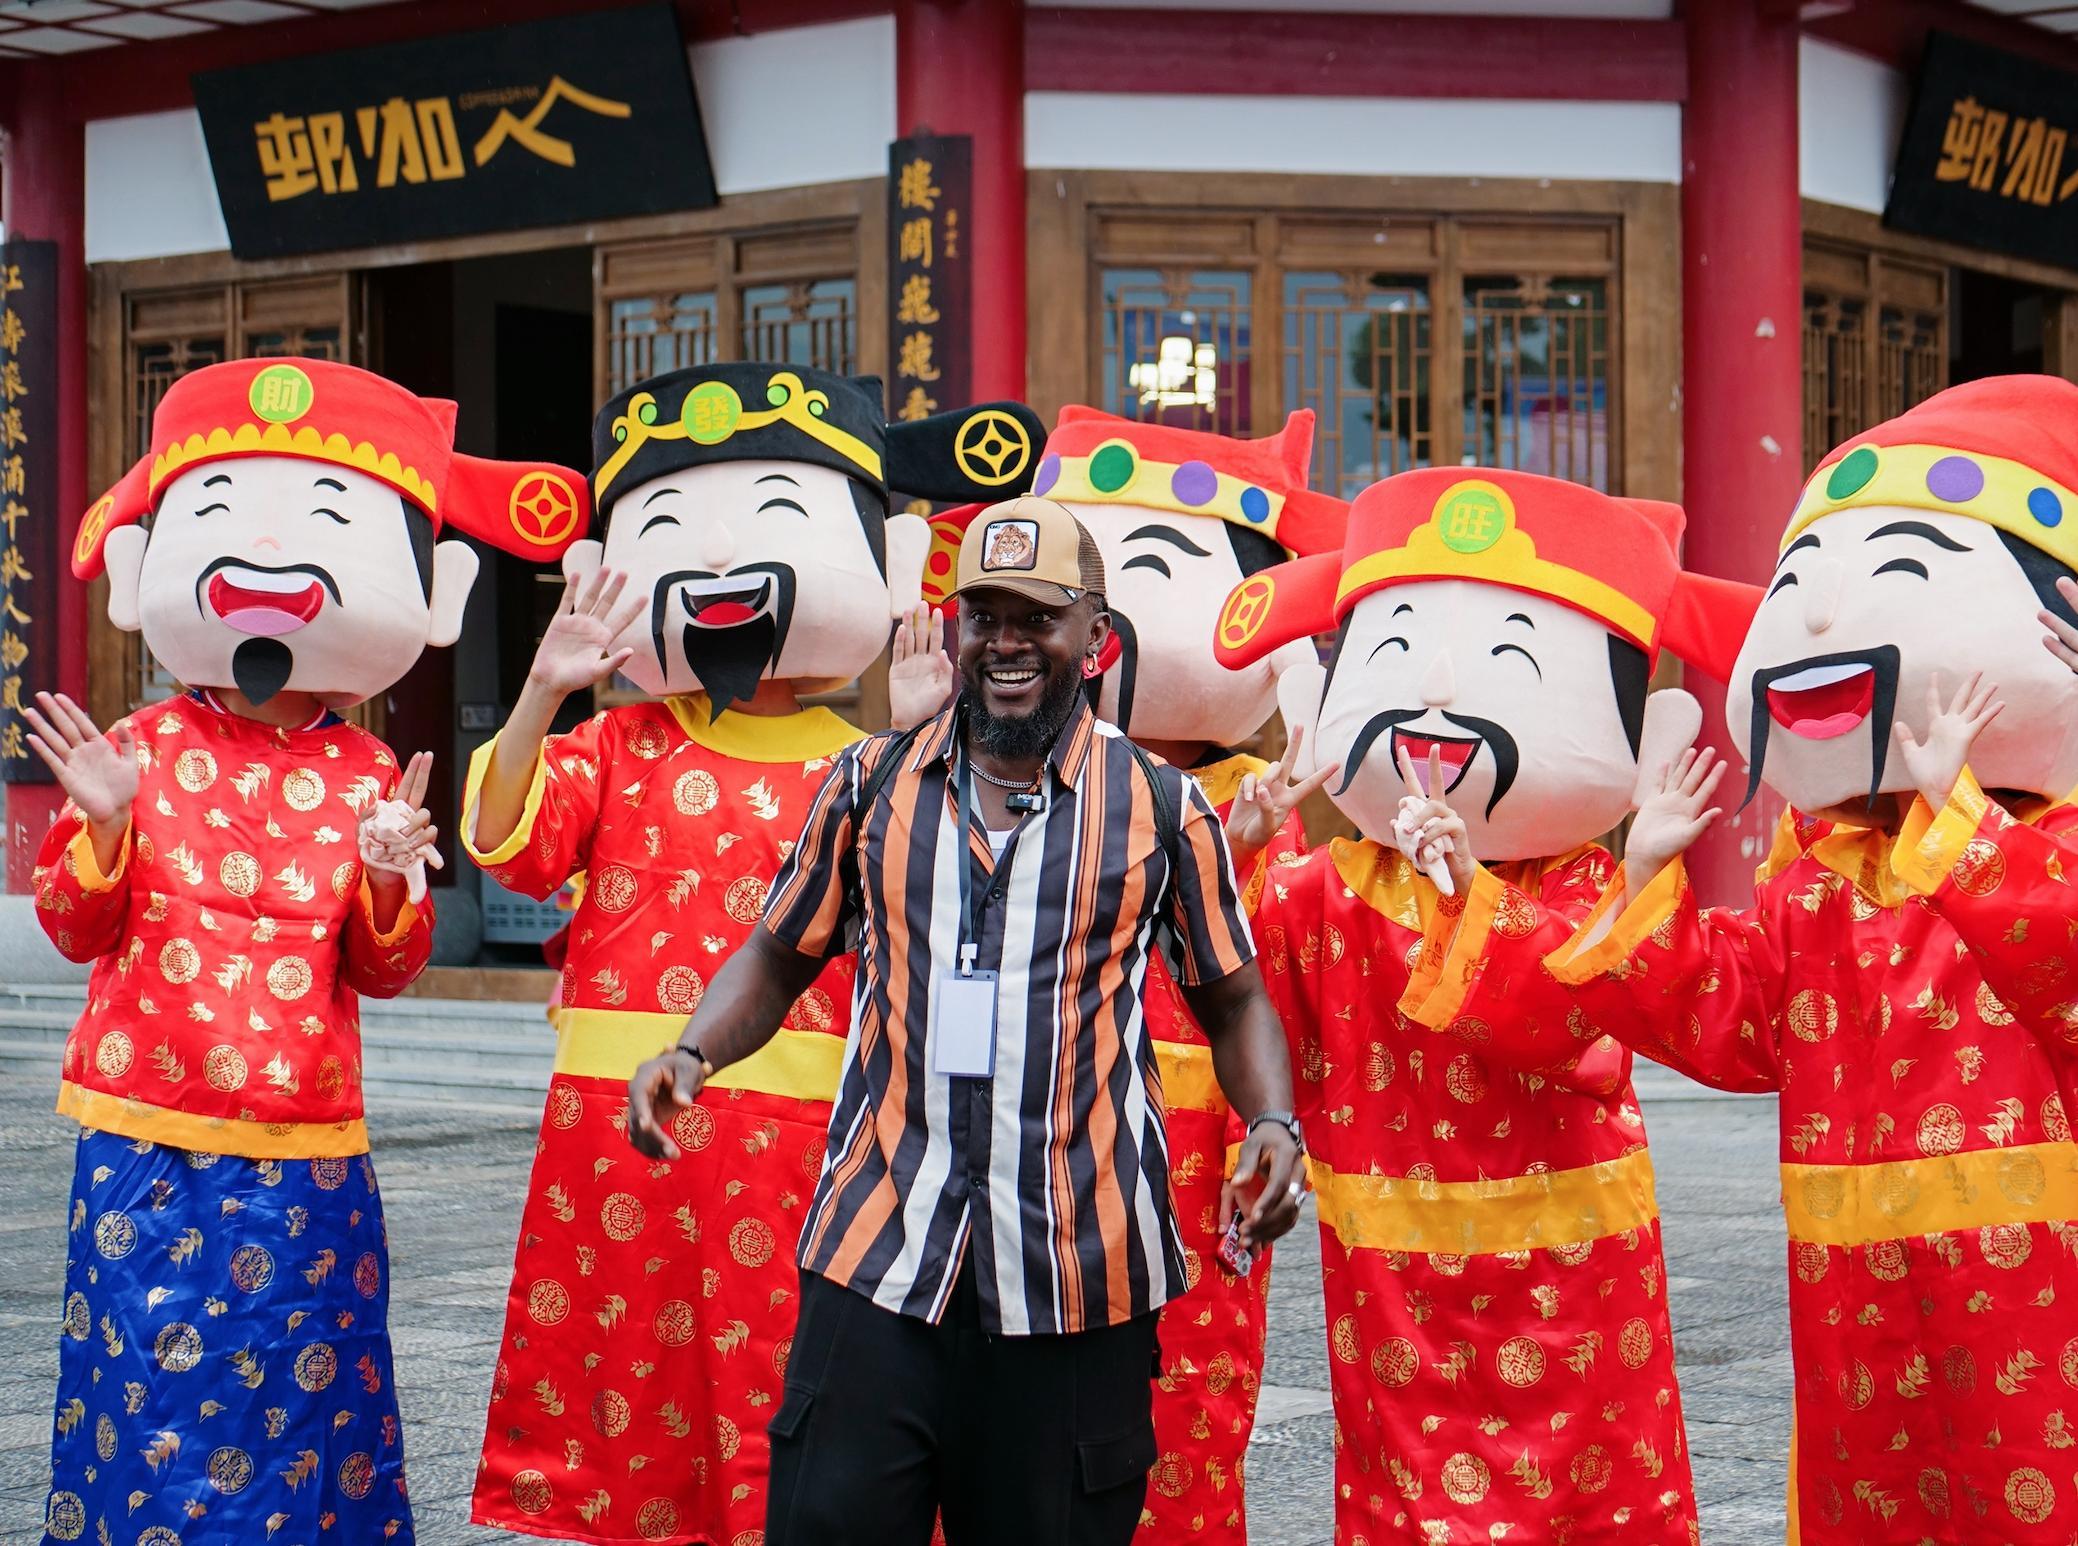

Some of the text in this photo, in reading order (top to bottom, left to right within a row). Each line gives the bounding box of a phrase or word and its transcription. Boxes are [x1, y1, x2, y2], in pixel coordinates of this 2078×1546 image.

[260, 375, 302, 413] 財
[694, 394, 729, 434] 發
[1448, 502, 1496, 542] 旺
